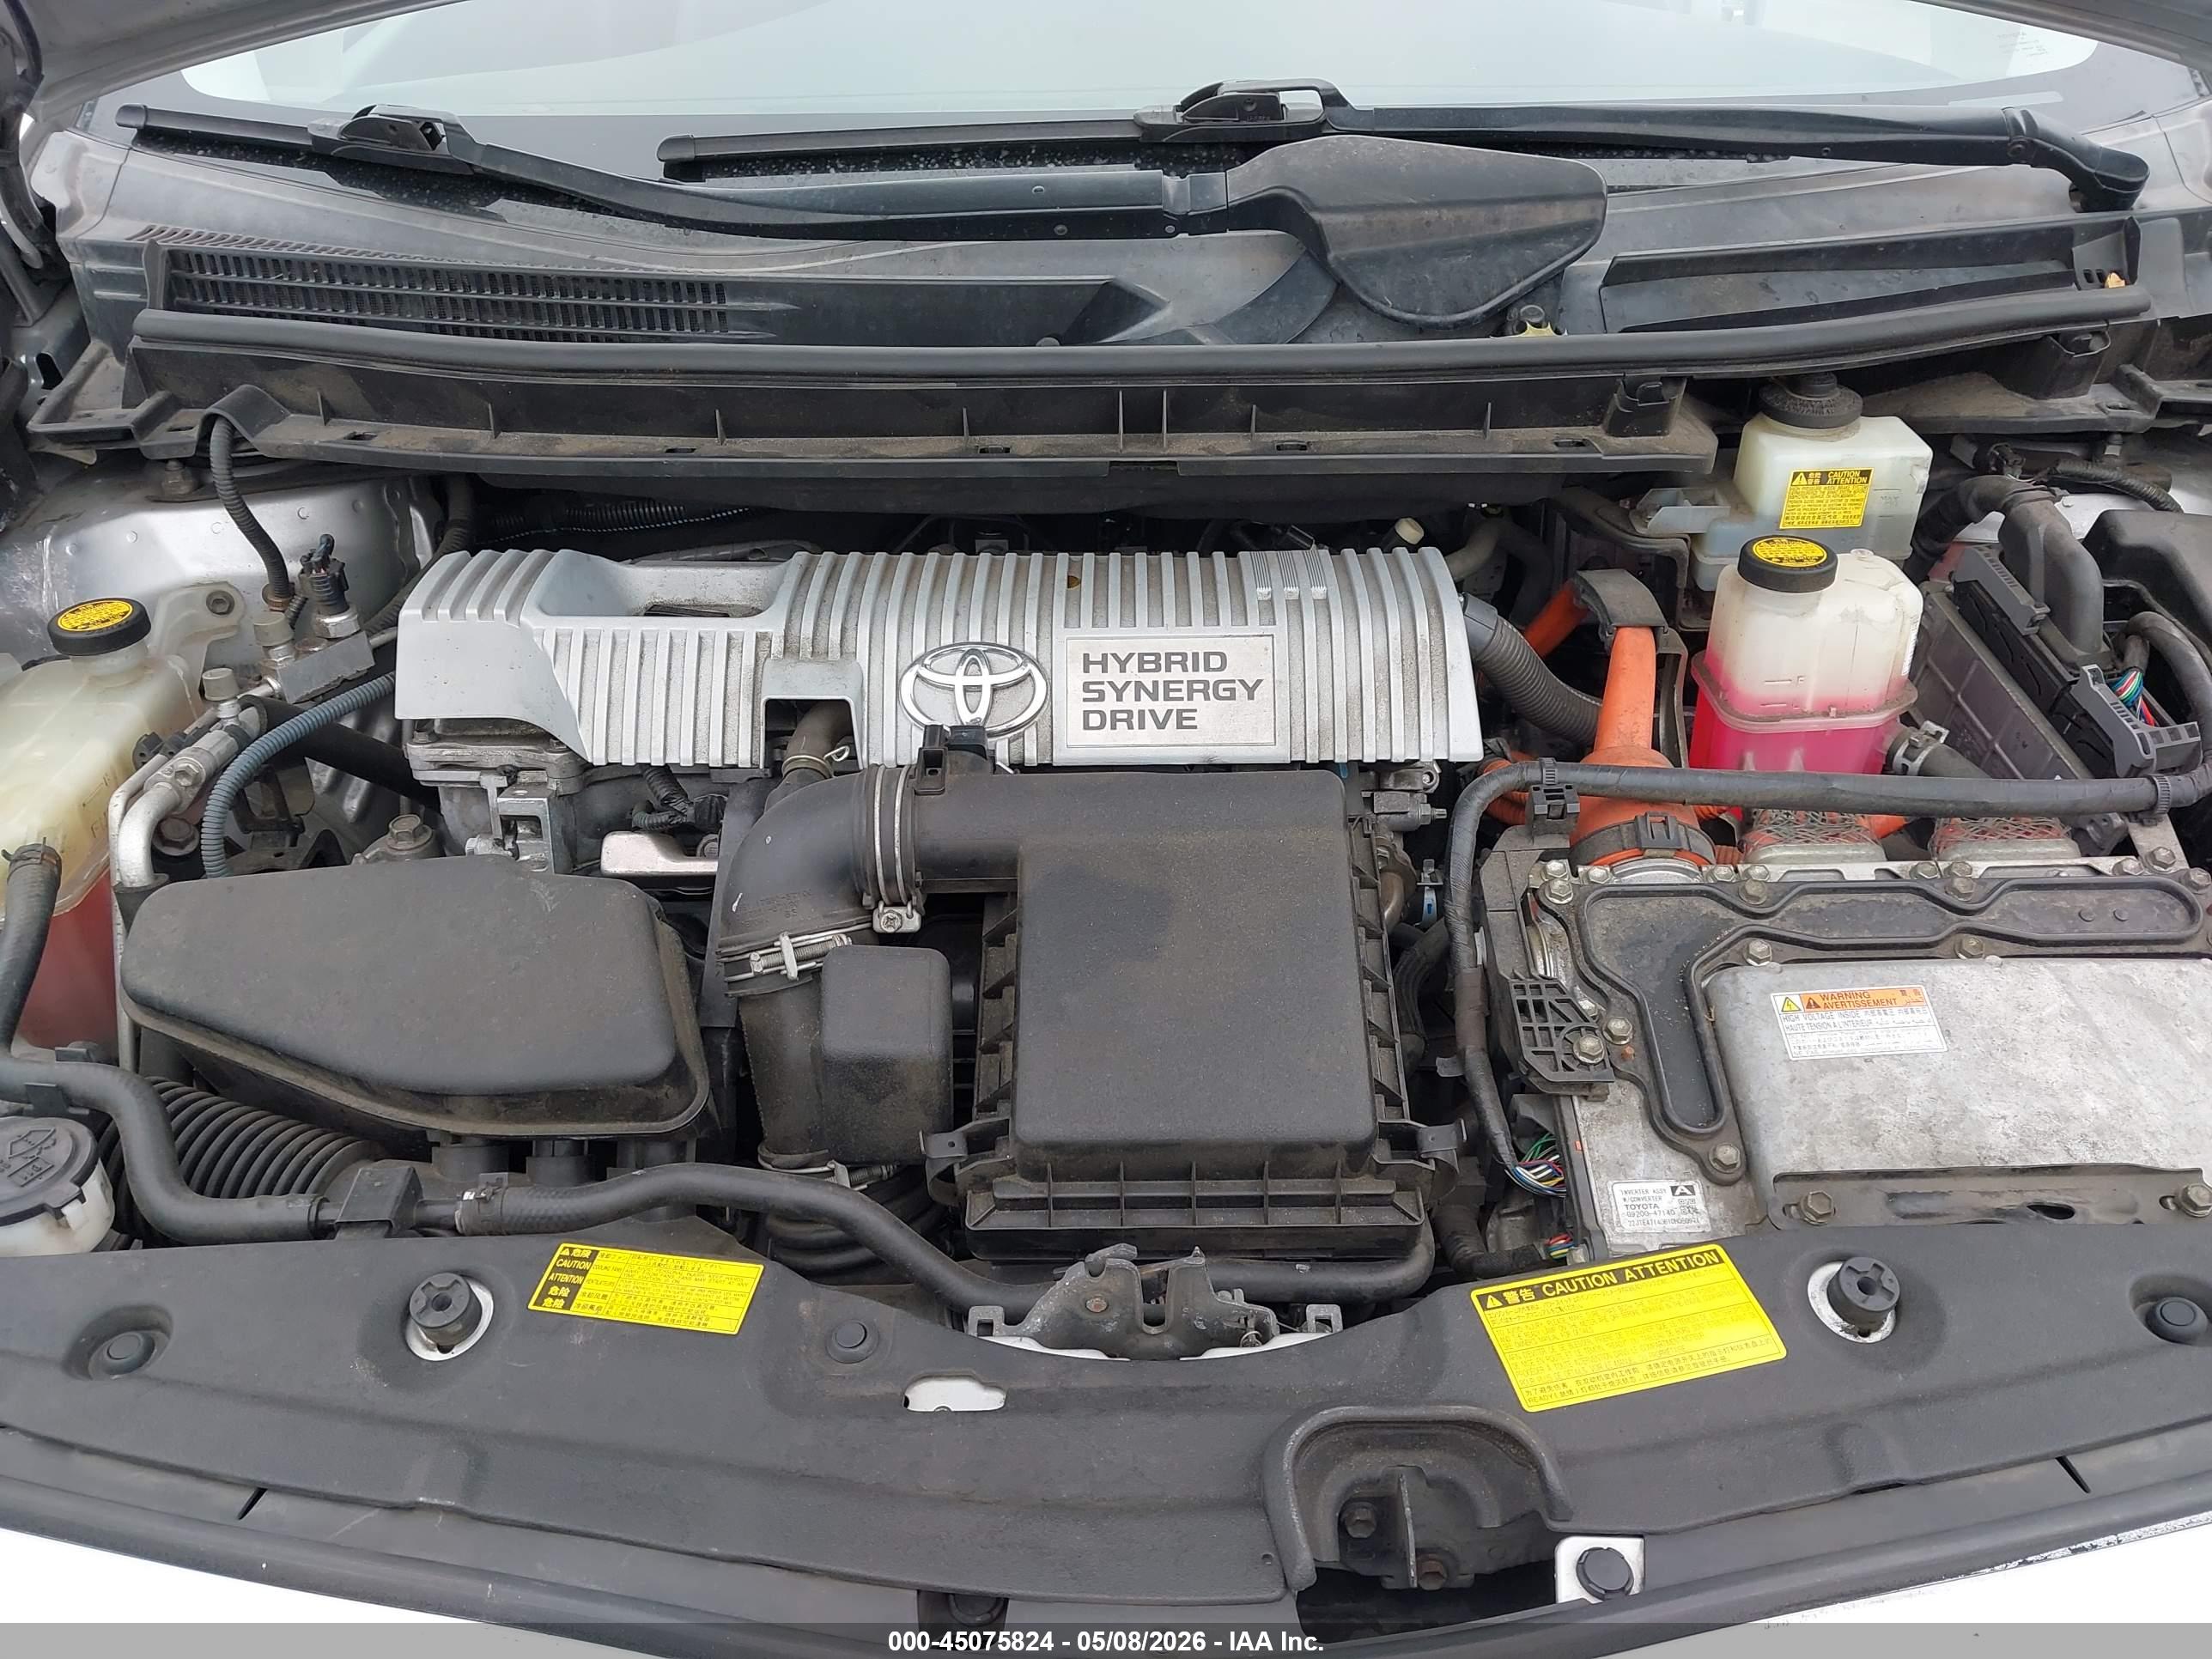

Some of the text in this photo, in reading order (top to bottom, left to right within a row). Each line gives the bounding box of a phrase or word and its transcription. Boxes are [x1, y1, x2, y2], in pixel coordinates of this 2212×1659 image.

[1083, 651, 1228, 673] HYBRID
[1082, 679, 1264, 702] SYNERGY
[1083, 708, 1198, 730] DRIVE
[1820, 991, 1871, 1001] WARNING
[1824, 998, 1897, 1010] AVERTISSEMENT
[1783, 1014, 1800, 1023] HIGH
[1803, 1012, 1834, 1021] VOLTAGE
[1838, 1010, 1861, 1018] INSIDE
[1786, 1023, 1806, 1031] HAUTE
[1807, 1022, 1832, 1030] TENSION
[556, 1259, 592, 1271] CAUTION
[549, 1273, 585, 1285] ATTENTION
[1503, 1251, 1719, 1306] 警告 CAUTION ATTENTION
